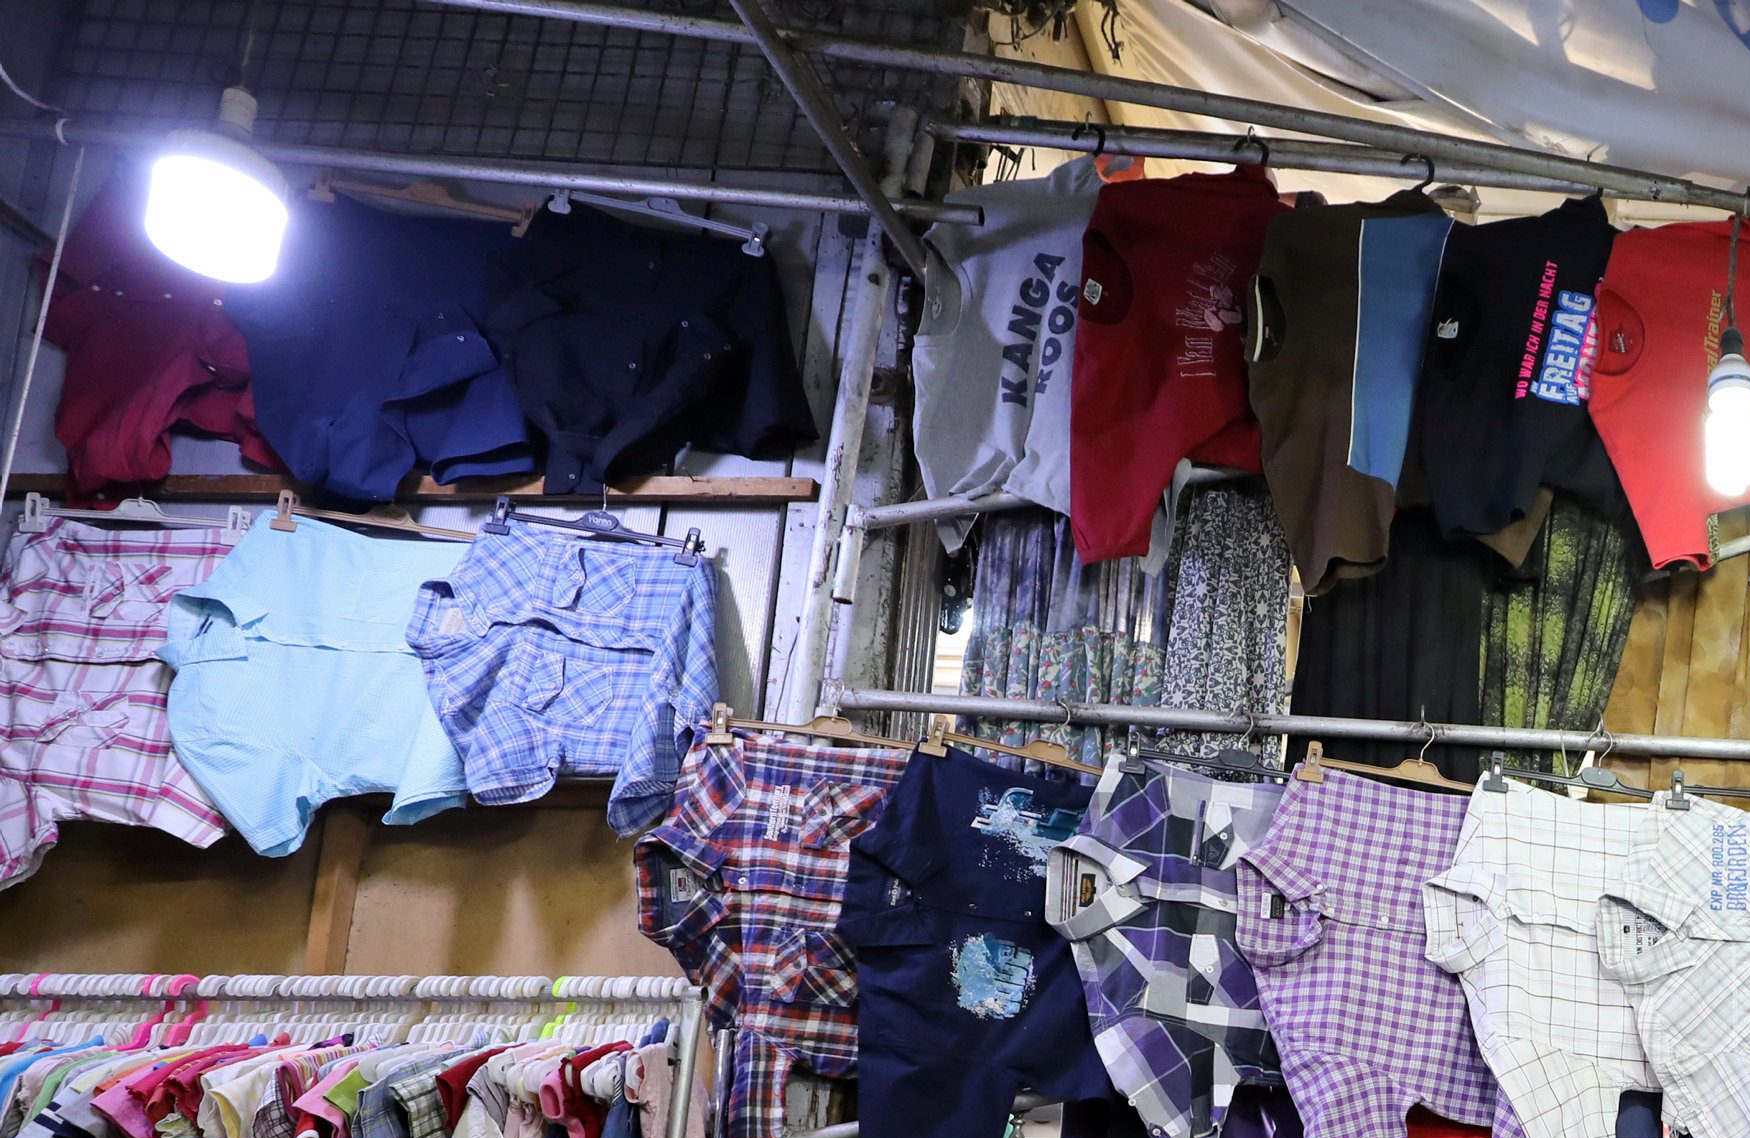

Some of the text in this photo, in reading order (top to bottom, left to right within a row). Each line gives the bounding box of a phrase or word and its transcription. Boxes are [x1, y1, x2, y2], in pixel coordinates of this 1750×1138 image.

[1538, 260, 1559, 300] NACHT
[1534, 300, 1550, 321] DER
[1704, 289, 1722, 348] Trainer
[1001, 252, 1066, 408] KANGA
[1035, 280, 1080, 394] ROOS
[1530, 320, 1545, 335] IN
[1526, 334, 1541, 355] ICH
[1538, 292, 1593, 401] FREITAG
[1518, 355, 1536, 379] WAR
[1515, 381, 1529, 400] WO
[1711, 871, 1723, 886] NR
[1710, 889, 1723, 911] EXP
